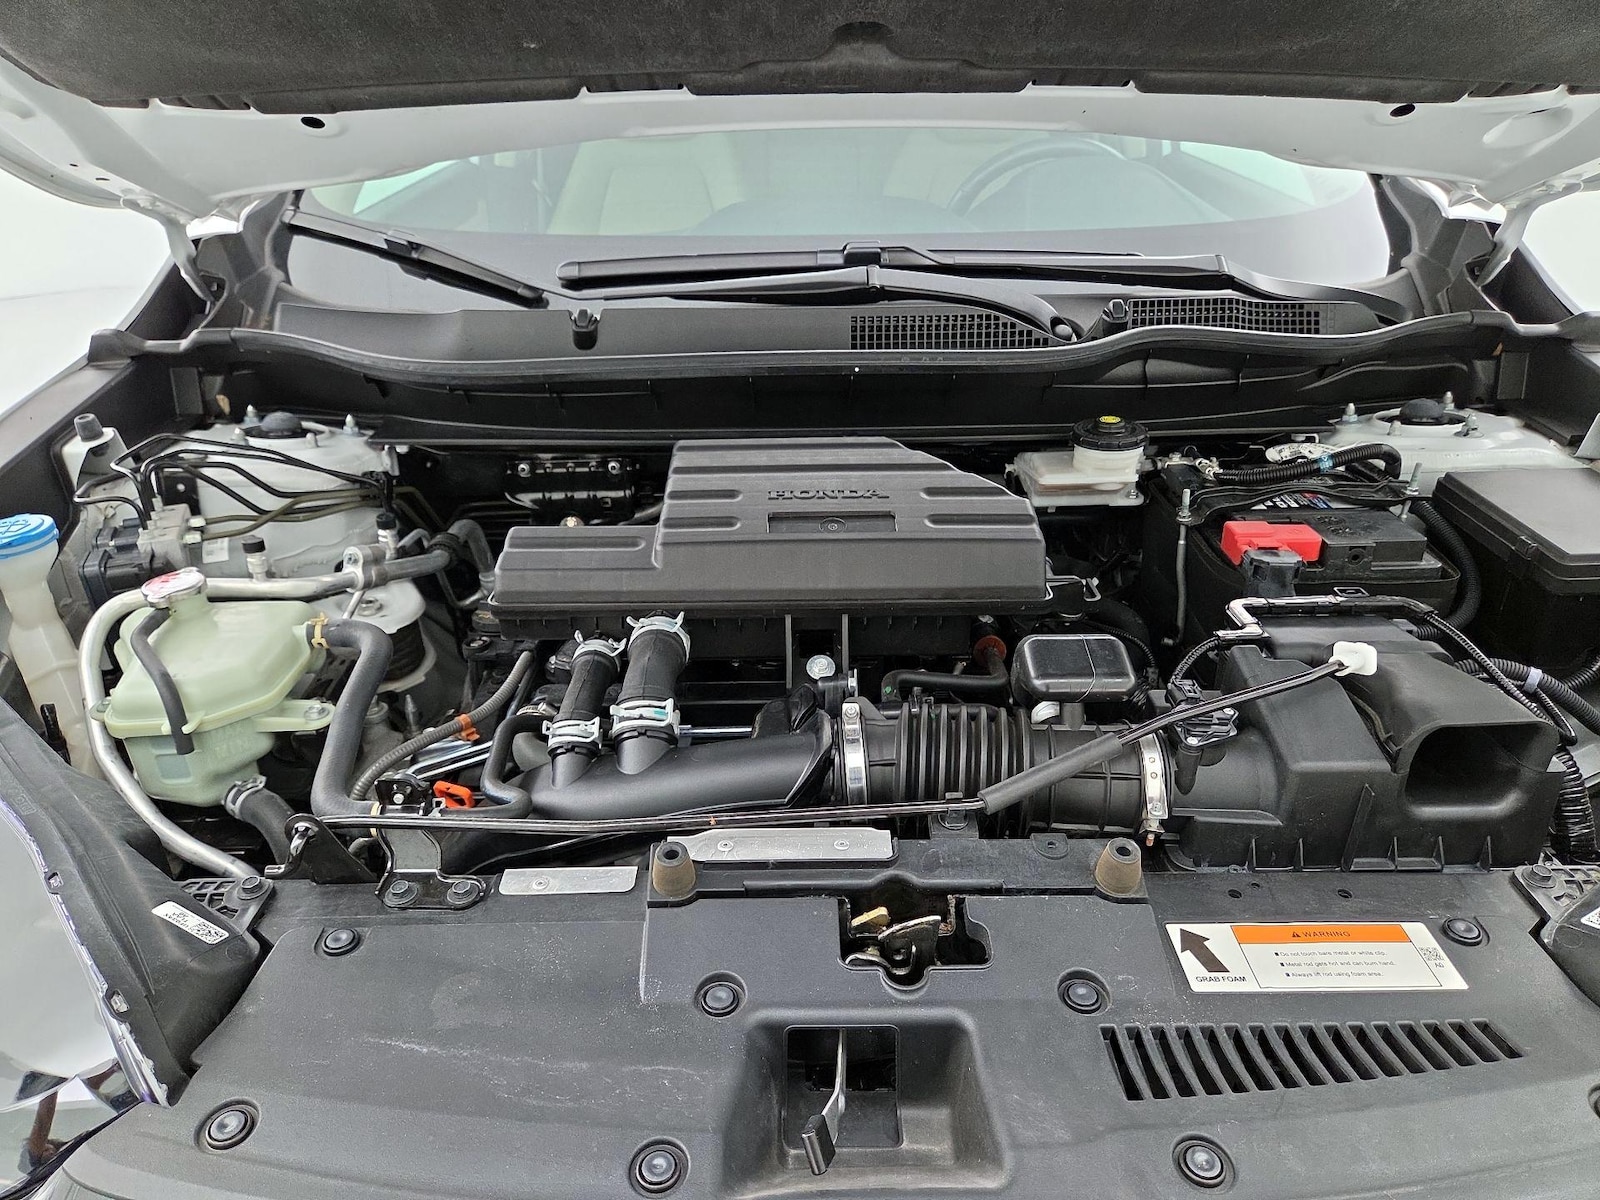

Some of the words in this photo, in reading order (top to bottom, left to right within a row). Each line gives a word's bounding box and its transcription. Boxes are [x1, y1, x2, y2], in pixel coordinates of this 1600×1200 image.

[767, 488, 890, 501] HONDA
[1195, 975, 1221, 983] GRAB
[1221, 975, 1248, 983] FOAM
